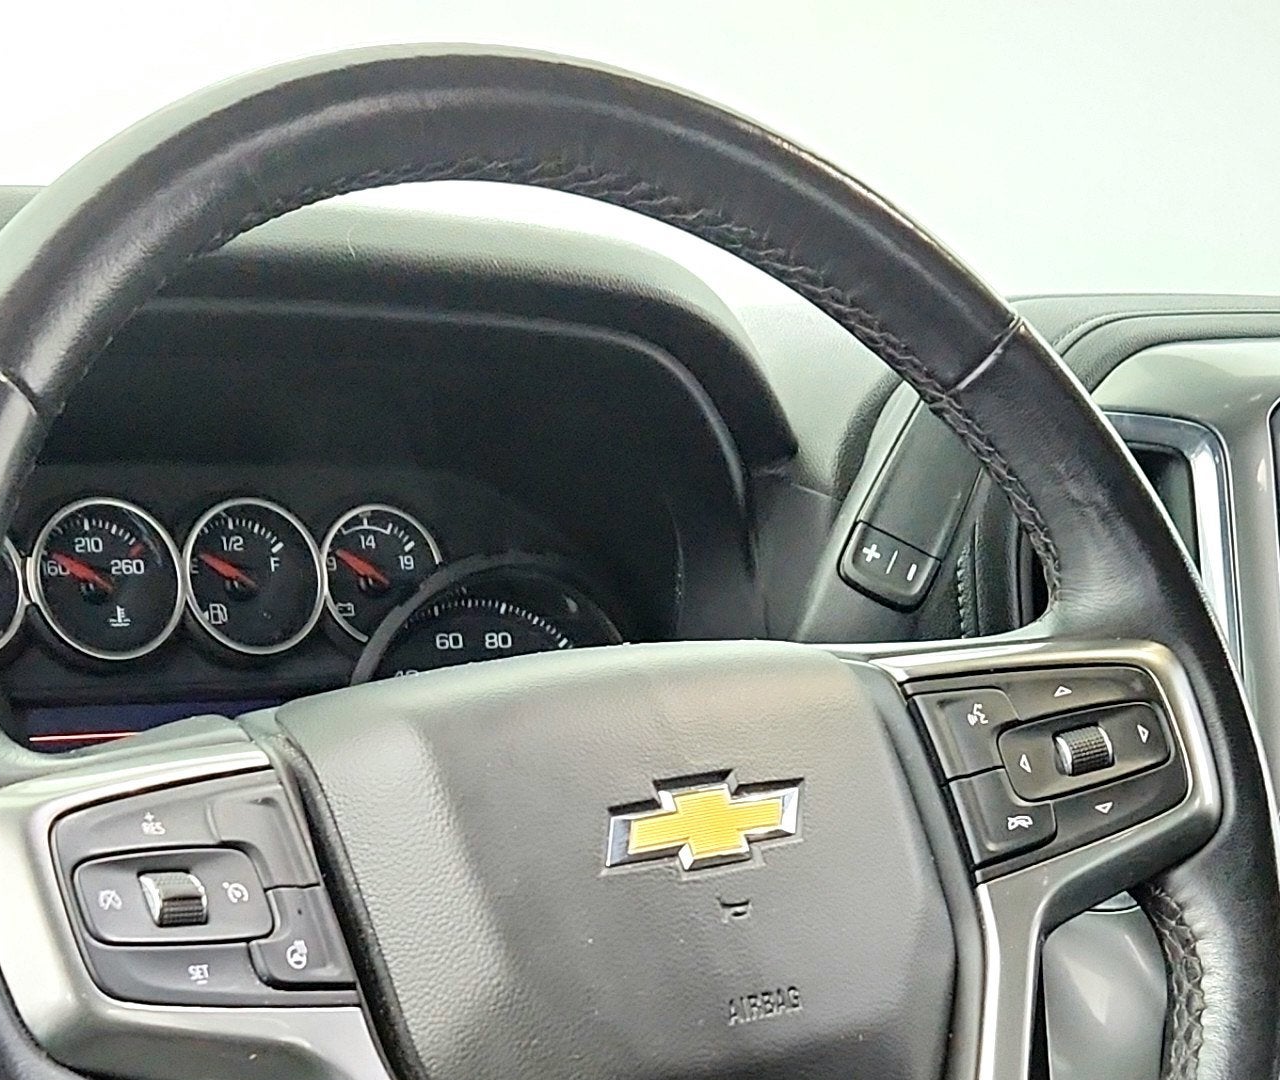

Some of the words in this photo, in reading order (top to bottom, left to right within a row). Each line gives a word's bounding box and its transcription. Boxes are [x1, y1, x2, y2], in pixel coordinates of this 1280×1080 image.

[74, 537, 103, 553] 210
[221, 535, 244, 551] 1/2
[359, 535, 376, 549] 14
[110, 559, 145, 575] 260
[270, 557, 281, 572] F
[399, 555, 415, 570] 19
[435, 633, 464, 650] 60
[484, 631, 513, 649] 80
[187, 963, 209, 980] SET
[728, 985, 803, 1026] AIRBAG
